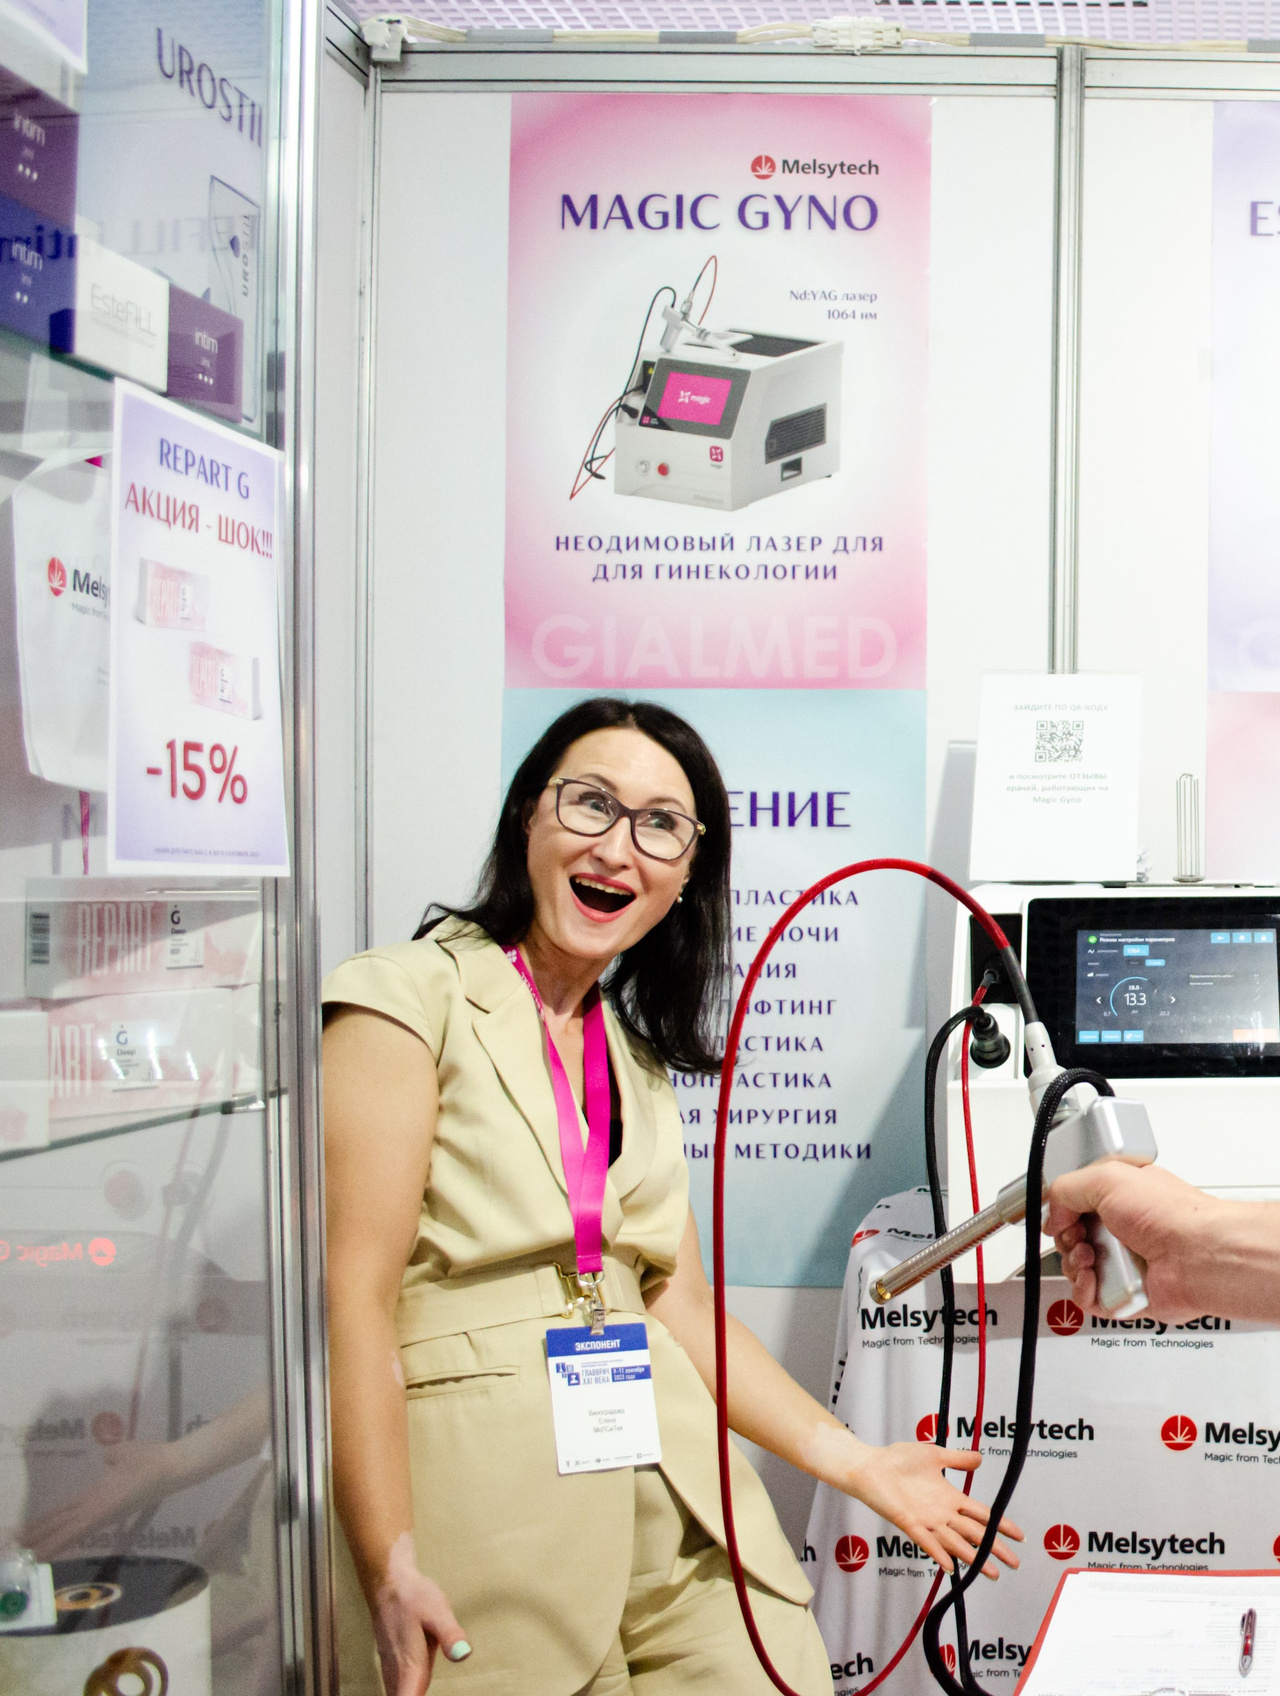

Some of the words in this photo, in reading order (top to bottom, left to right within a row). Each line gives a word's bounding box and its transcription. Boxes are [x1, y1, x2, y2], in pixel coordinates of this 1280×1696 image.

[782, 159, 879, 178] Melsytech
[560, 193, 720, 231] MAGIC
[737, 193, 880, 231] GYNO
[789, 289, 839, 302] Nd:YAG
[841, 291, 878, 304] лазер
[826, 308, 857, 321] 1064
[860, 311, 878, 321] нм
[159, 437, 232, 492] REPART
[237, 471, 250, 500] G
[124, 482, 200, 534] АКЦИЯ
[218, 513, 273, 560] ШОК!!!
[555, 532, 735, 553] НЕОДИМОВЫЙ
[746, 535, 823, 553] ЛАЗЕР
[833, 535, 884, 554] ДЛЯ
[592, 562, 644, 583] ДЛЯ
[654, 563, 838, 581] ГИНЕКОЛОГИИ
[530, 613, 900, 681] GIALMED
[1013, 702, 1052, 712] ЗАЙДИТЕ
[1055, 703, 1067, 711] ПО
[1069, 703, 1108, 712] QR-КОДУ
[146, 738, 248, 805] -15%
[1032, 795, 1057, 804] Magic
[1060, 795, 1082, 804] Gyno
[769, 926, 839, 942] ОЧИ
[733, 962, 797, 979] АИЯ
[1124, 992, 1147, 1006] 13.3
[714, 1036, 824, 1052] ЛСТИКА
[671, 1072, 832, 1088] НОПАСТИКА
[735, 1143, 872, 1162] МЕТОДИКИ
[575, 1339, 621, 1352] ЭКСПОНЕНТ
[862, 1338, 891, 1349] Magic
[893, 1336, 915, 1347] from
[918, 1335, 980, 1346] Techogies
[1091, 1337, 1120, 1349] Magic
[1123, 1337, 1147, 1347] from
[1150, 1338, 1214, 1350] Technologies
[581, 1367, 610, 1378] ГЛАВВРАЧ
[595, 1376, 610, 1385] ВЕКА
[957, 1415, 1095, 1441] Melstech
[1026, 1448, 1078, 1460] chnologies
[1204, 1452, 1233, 1464] Magic
[1236, 1453, 1259, 1463] from
[1088, 1531, 1225, 1561] Melsytech
[878, 1567, 905, 1578] Magic
[907, 1566, 924, 1578] from
[986, 1668, 1010, 1678] from
